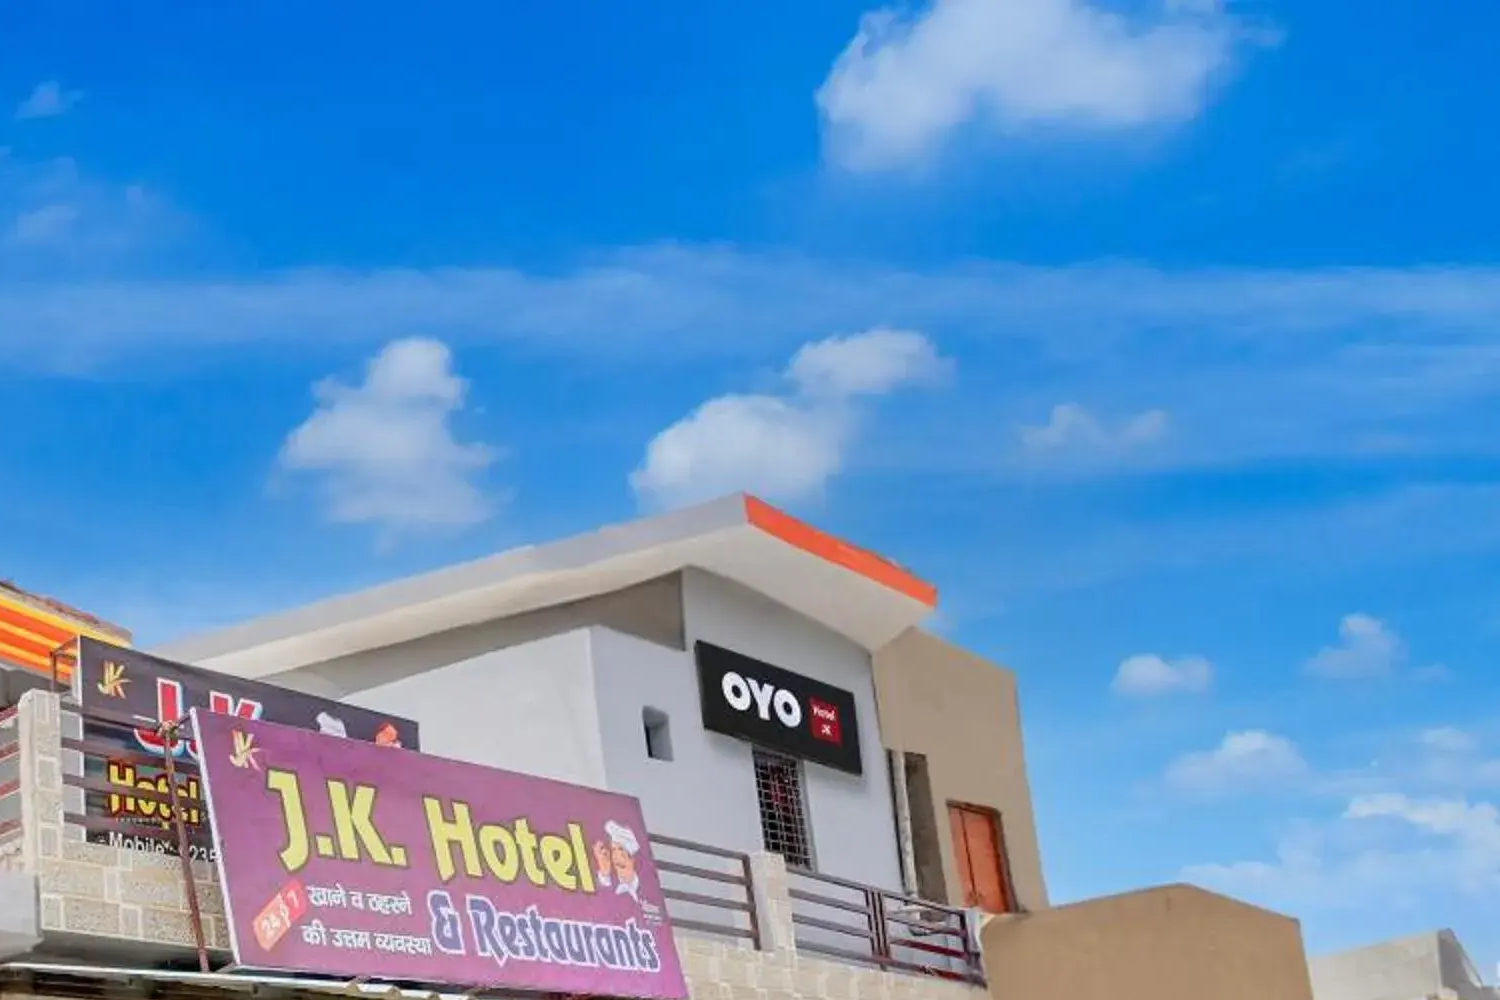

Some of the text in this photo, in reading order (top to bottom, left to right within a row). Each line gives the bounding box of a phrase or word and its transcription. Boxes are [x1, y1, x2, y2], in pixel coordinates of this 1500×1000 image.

[721, 671, 802, 728] OYO
[266, 768, 596, 894] J.K. Hotel
[305, 883, 348, 909] खाने
[301, 918, 433, 956] की उत्तम व्यवस्था
[426, 889, 661, 973] & Restaurants
